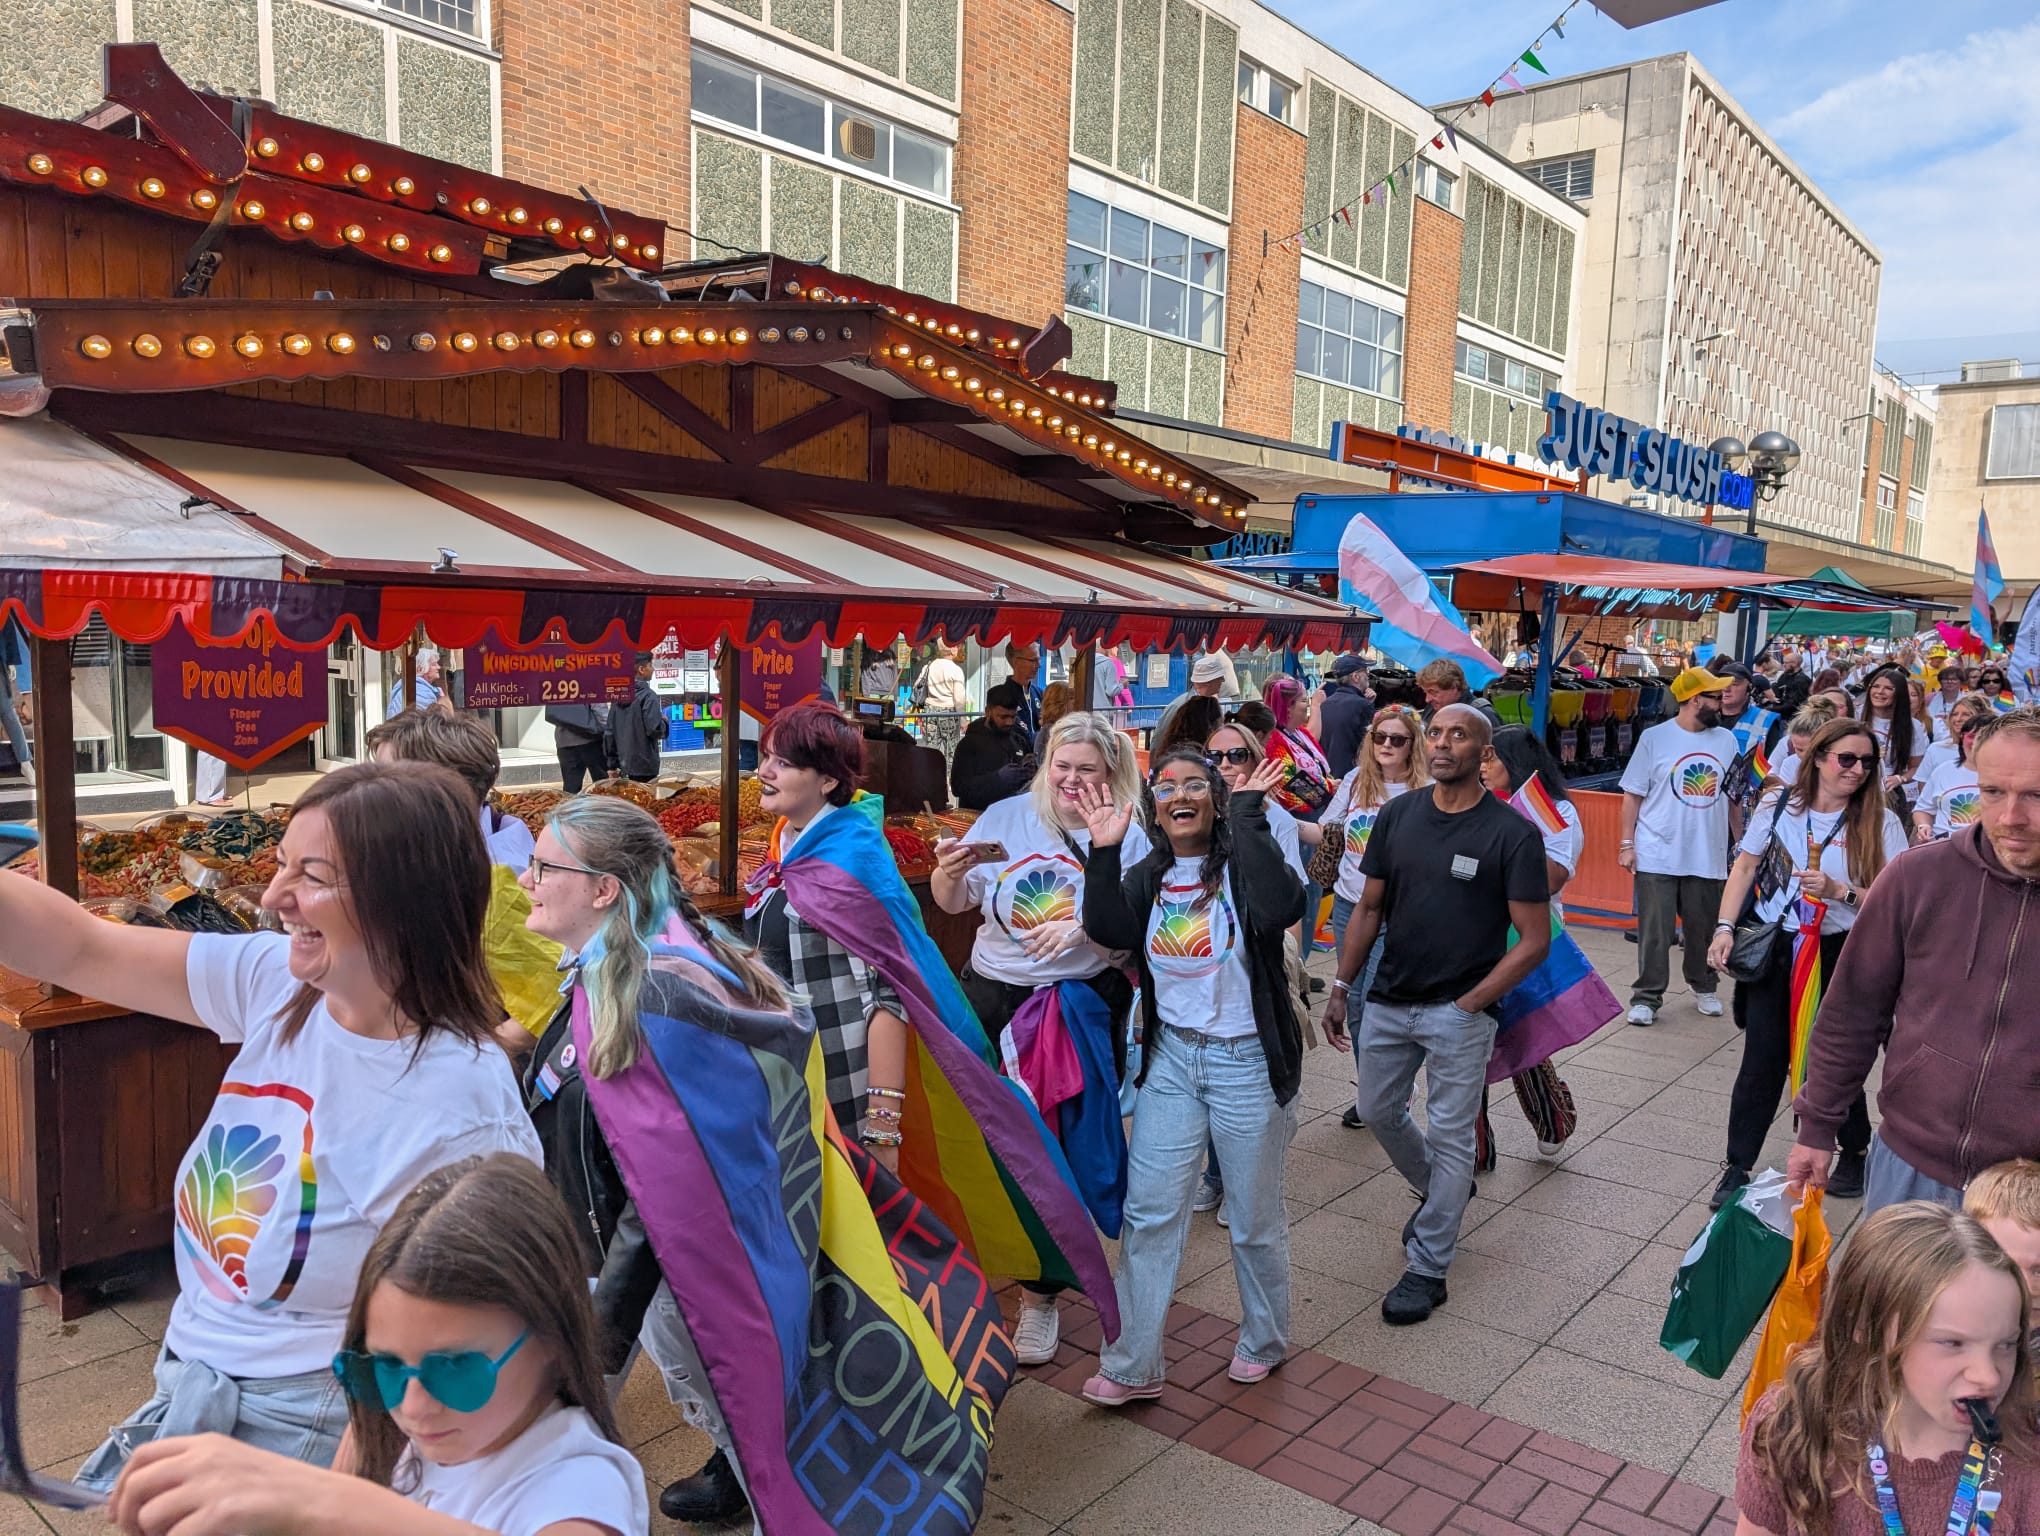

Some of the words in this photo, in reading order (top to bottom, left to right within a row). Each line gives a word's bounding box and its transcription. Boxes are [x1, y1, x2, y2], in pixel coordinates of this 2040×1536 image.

[1538, 389, 1640, 483] JUST
[1630, 428, 1722, 505] SLUSH
[483, 652, 556, 675] KINGDOM
[555, 658, 567, 668] OF
[565, 653, 622, 669] SWEETS
[752, 646, 794, 676] Price
[182, 661, 303, 699] Provided
[474, 683, 488, 694] All
[490, 682, 518, 693] Kinds
[541, 680, 580, 701] 2.99
[469, 696, 498, 707] Same
[500, 694, 524, 705] Price
[230, 708, 262, 719] Finger
[671, 703, 722, 721] HELLO
[235, 722, 256, 732] Free
[234, 735, 259, 746] Zone
[776, 1084, 988, 1526] WECOME
